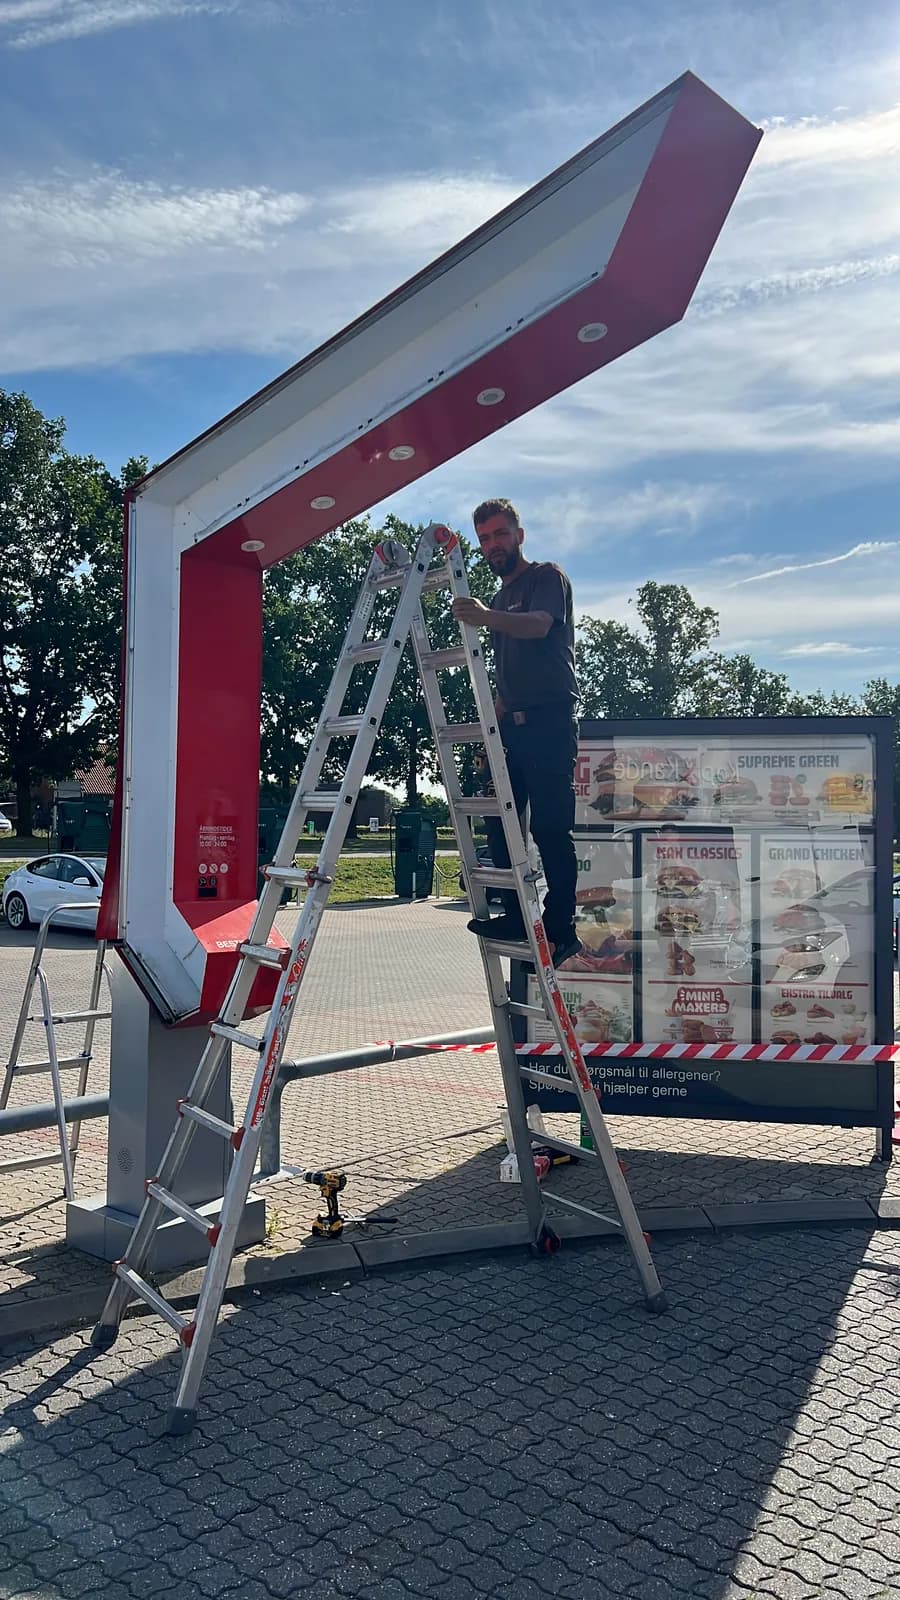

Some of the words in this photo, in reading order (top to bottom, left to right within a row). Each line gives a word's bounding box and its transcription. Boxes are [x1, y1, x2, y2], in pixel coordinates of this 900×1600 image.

[738, 755, 795, 768] SUPREME
[799, 754, 840, 768] GREEN
[656, 847, 683, 860] MAX
[686, 847, 743, 860] CLASSICS
[768, 847, 810, 861] GRAND
[813, 847, 865, 861] CHICKEN
[685, 990, 715, 1001] MINI
[818, 990, 853, 1000] TILVALG
[674, 1002, 729, 1013] MAXERS
[528, 1062, 550, 1074] Har
[553, 1062, 568, 1075] du
[639, 1067, 649, 1078] til
[652, 1068, 721, 1083] allergener?
[603, 1082, 649, 1097] hjælper
[652, 1085, 688, 1098] gerne
